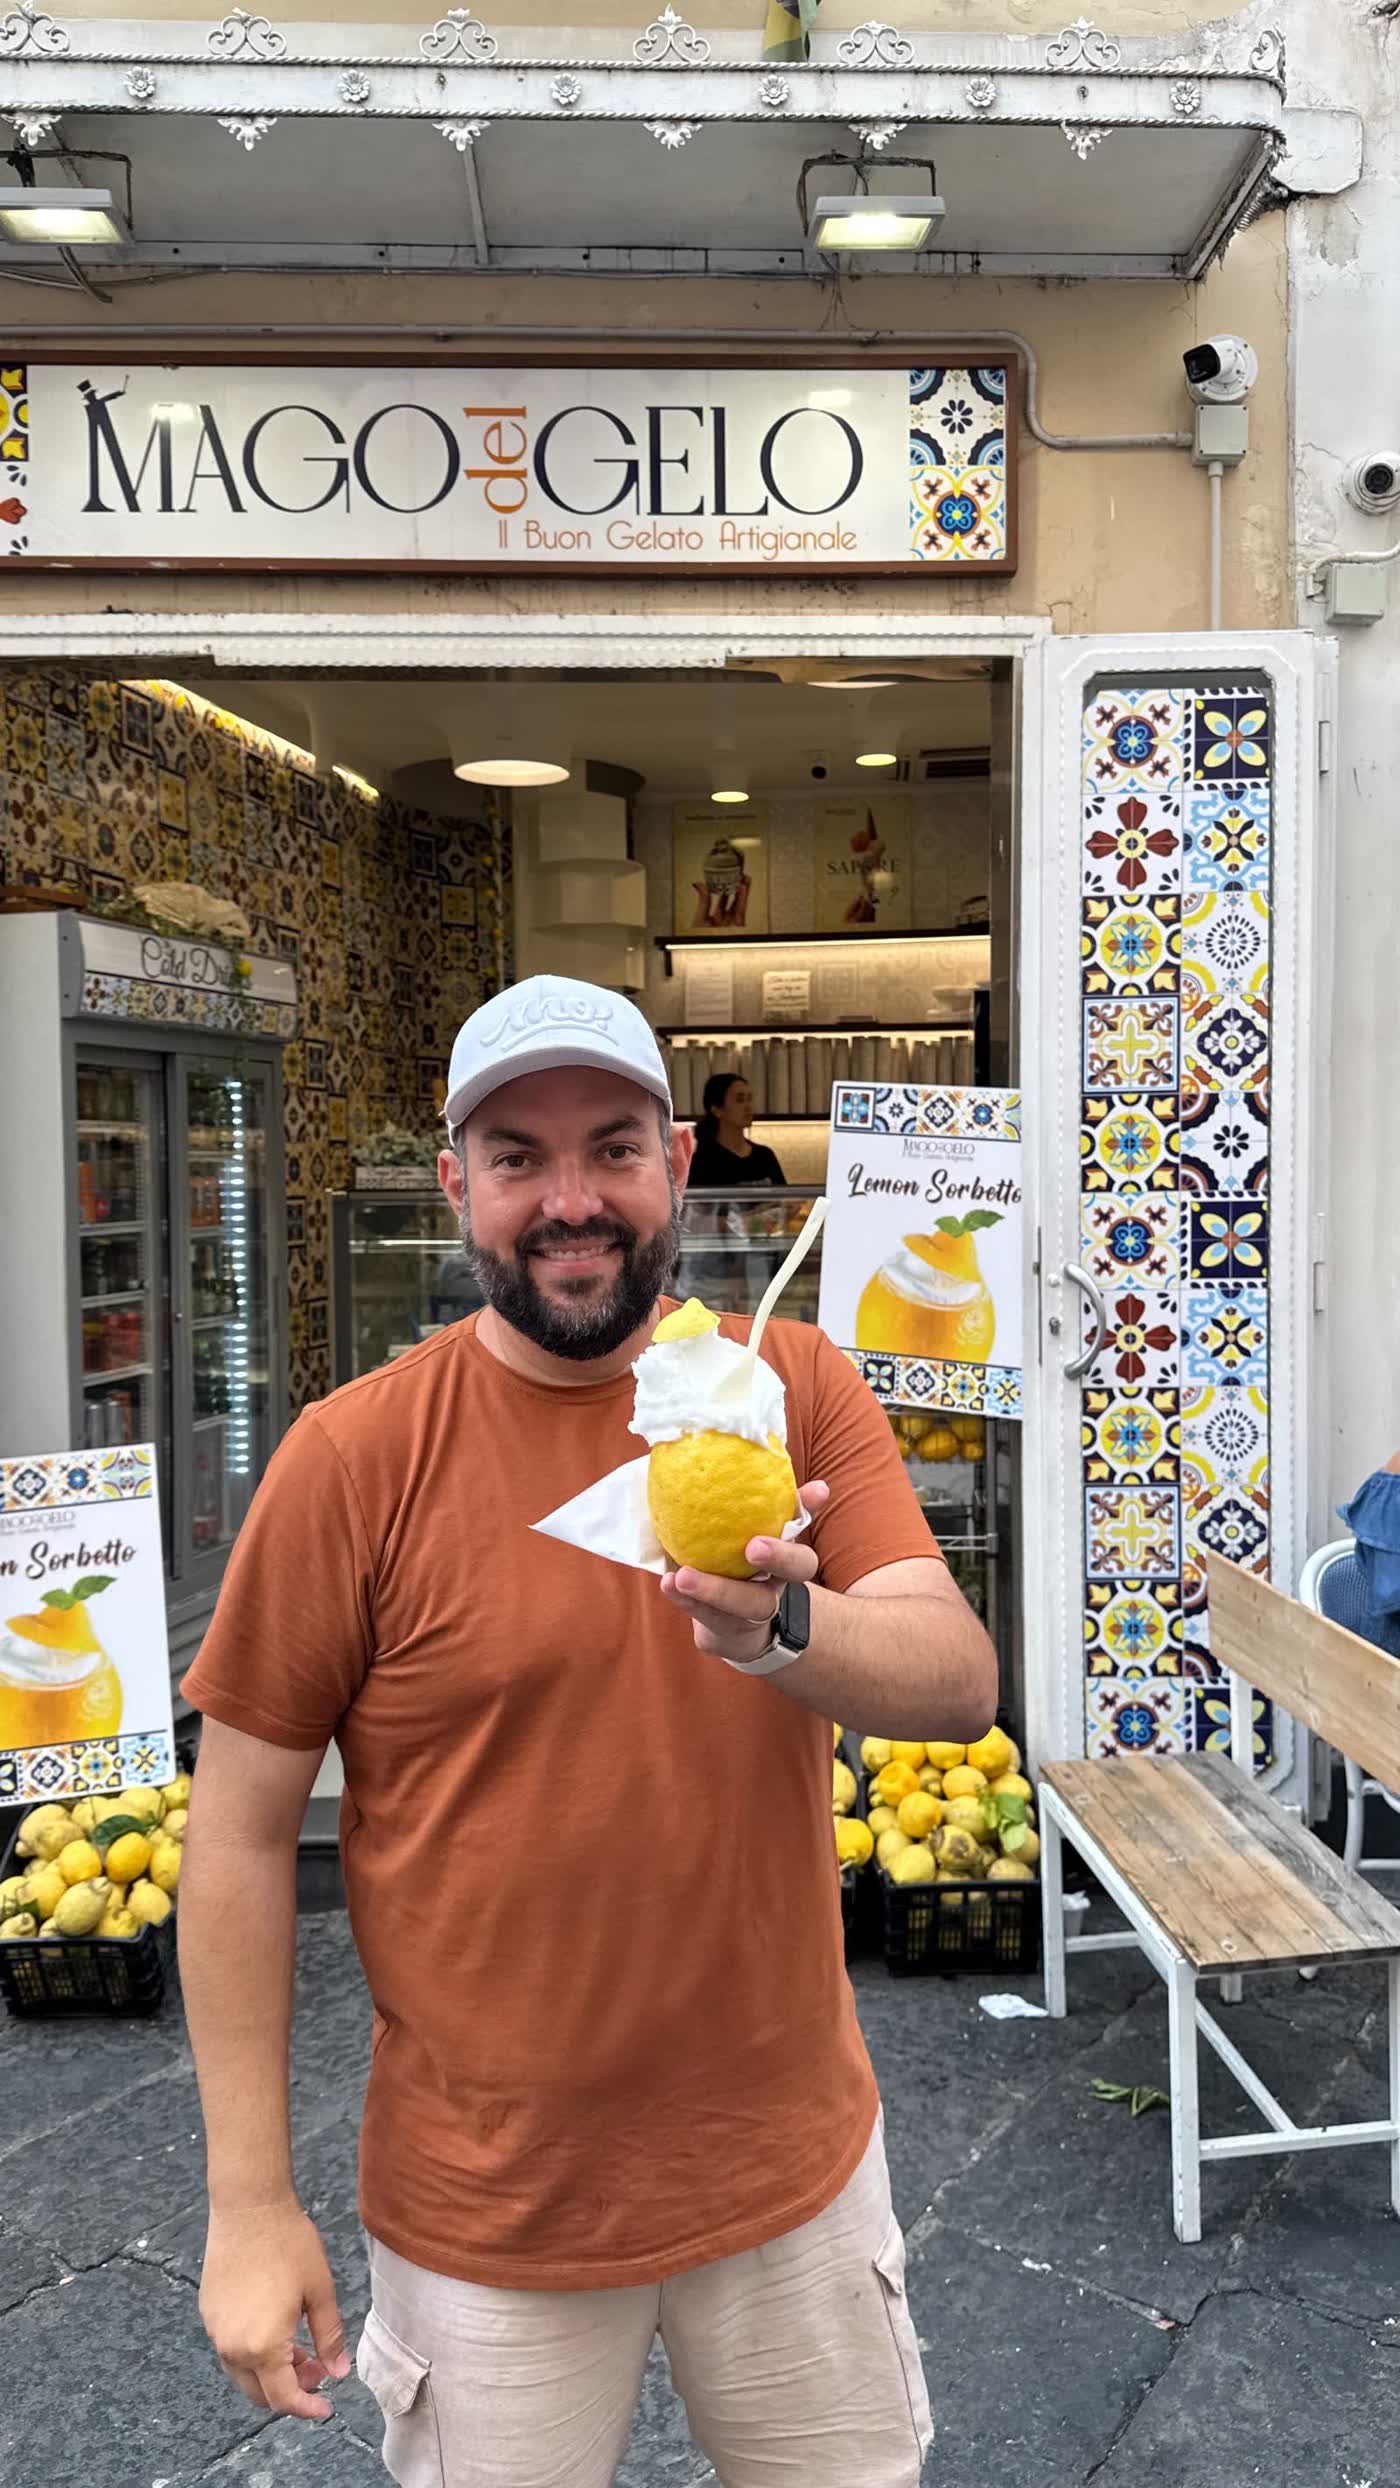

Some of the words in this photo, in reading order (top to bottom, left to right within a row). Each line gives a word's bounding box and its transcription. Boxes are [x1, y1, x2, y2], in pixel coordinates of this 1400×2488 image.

[81, 402, 461, 514] MAGO
[463, 405, 529, 515] del
[533, 405, 864, 516] GELO
[524, 519, 592, 550] Buon
[606, 519, 704, 551] Gelato
[719, 519, 858, 561] Artigianale
[141, 936, 188, 980] Cold
[848, 1162, 919, 1198] Lemon
[924, 1168, 1023, 1204] Sorbetto
[25, 1538, 137, 1580] Sorbetto
